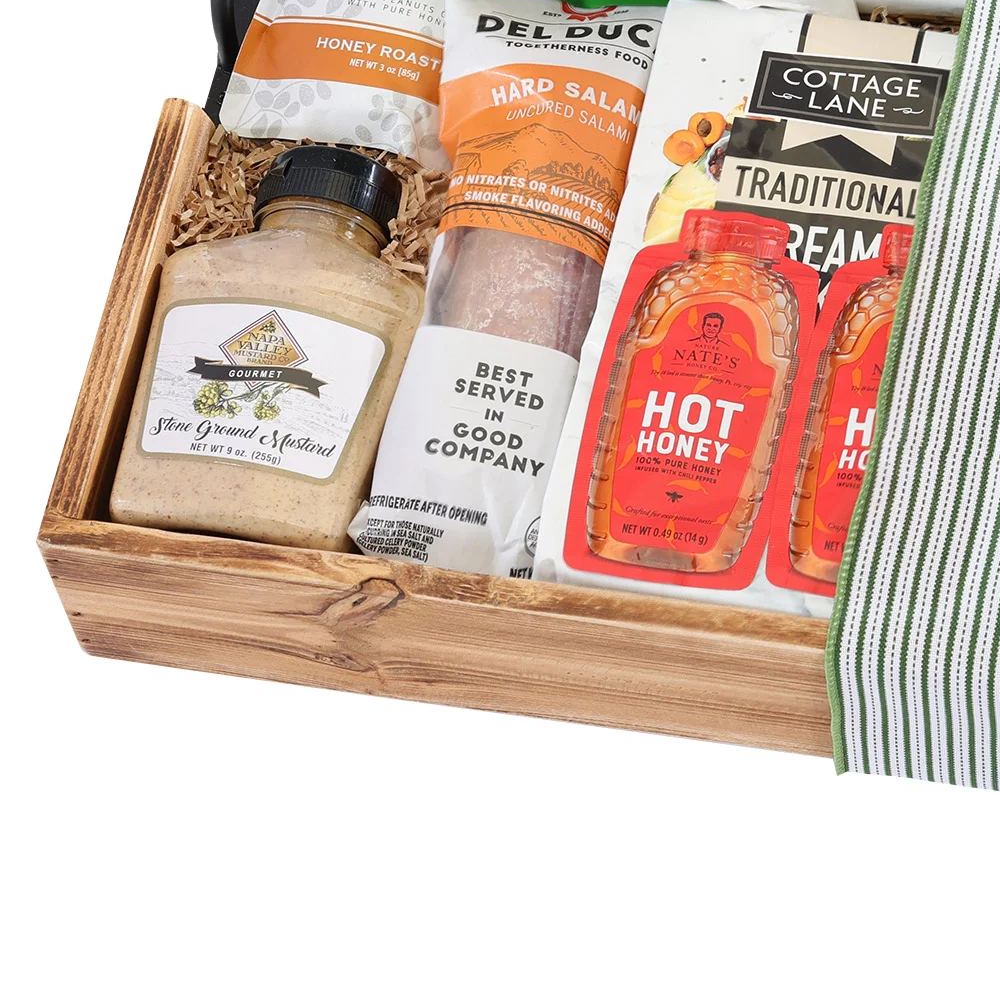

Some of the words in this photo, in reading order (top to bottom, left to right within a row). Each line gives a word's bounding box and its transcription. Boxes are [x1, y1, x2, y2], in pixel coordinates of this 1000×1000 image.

[476, 14, 552, 39] DEL
[565, 23, 656, 53] DUC
[316, 36, 376, 56] HONEY
[380, 46, 442, 73] ROAST
[506, 41, 609, 57] TOGETHERNESS
[615, 51, 648, 70] FOOD
[491, 78, 554, 107] HARD
[782, 67, 921, 98] COTTAGE
[808, 91, 886, 118] LANE
[506, 100, 574, 121] UNCURED
[579, 110, 631, 144] SALAMI
[450, 175, 464, 188] NO
[466, 174, 525, 188] NITRATES
[528, 180, 547, 194] OR
[549, 186, 604, 214] NITRITES
[464, 191, 507, 204] SMOKE
[510, 194, 582, 222] FLAVORING
[736, 165, 917, 219] TRADITIONAL
[237, 340, 292, 356] VALLEY
[248, 332, 286, 345] NAPA
[234, 350, 276, 361] MUSTARD
[673, 349, 739, 369] NATE'S
[229, 370, 282, 379] GOURMET
[476, 361, 533, 387] BEST
[455, 378, 544, 410] SERVED
[484, 408, 504, 423] IN
[641, 390, 744, 440] HOT
[149, 416, 193, 436] Stone
[196, 419, 258, 441] Ground
[259, 430, 336, 459] Mustard
[453, 422, 523, 450] GOOD
[636, 430, 730, 465] HONEY
[190, 443, 208, 452] NET
[210, 444, 224, 454] WT
[226, 446, 232, 455] 9
[234, 448, 247, 457] oz.
[251, 450, 282, 466] (255g)
[425, 438, 545, 477] COMPANY
[636, 456, 661, 465] 100%
[665, 459, 688, 470] PURE
[692, 464, 721, 476] HONEY
[420, 500, 447, 517] AFTER
[449, 506, 488, 526] OPENING
